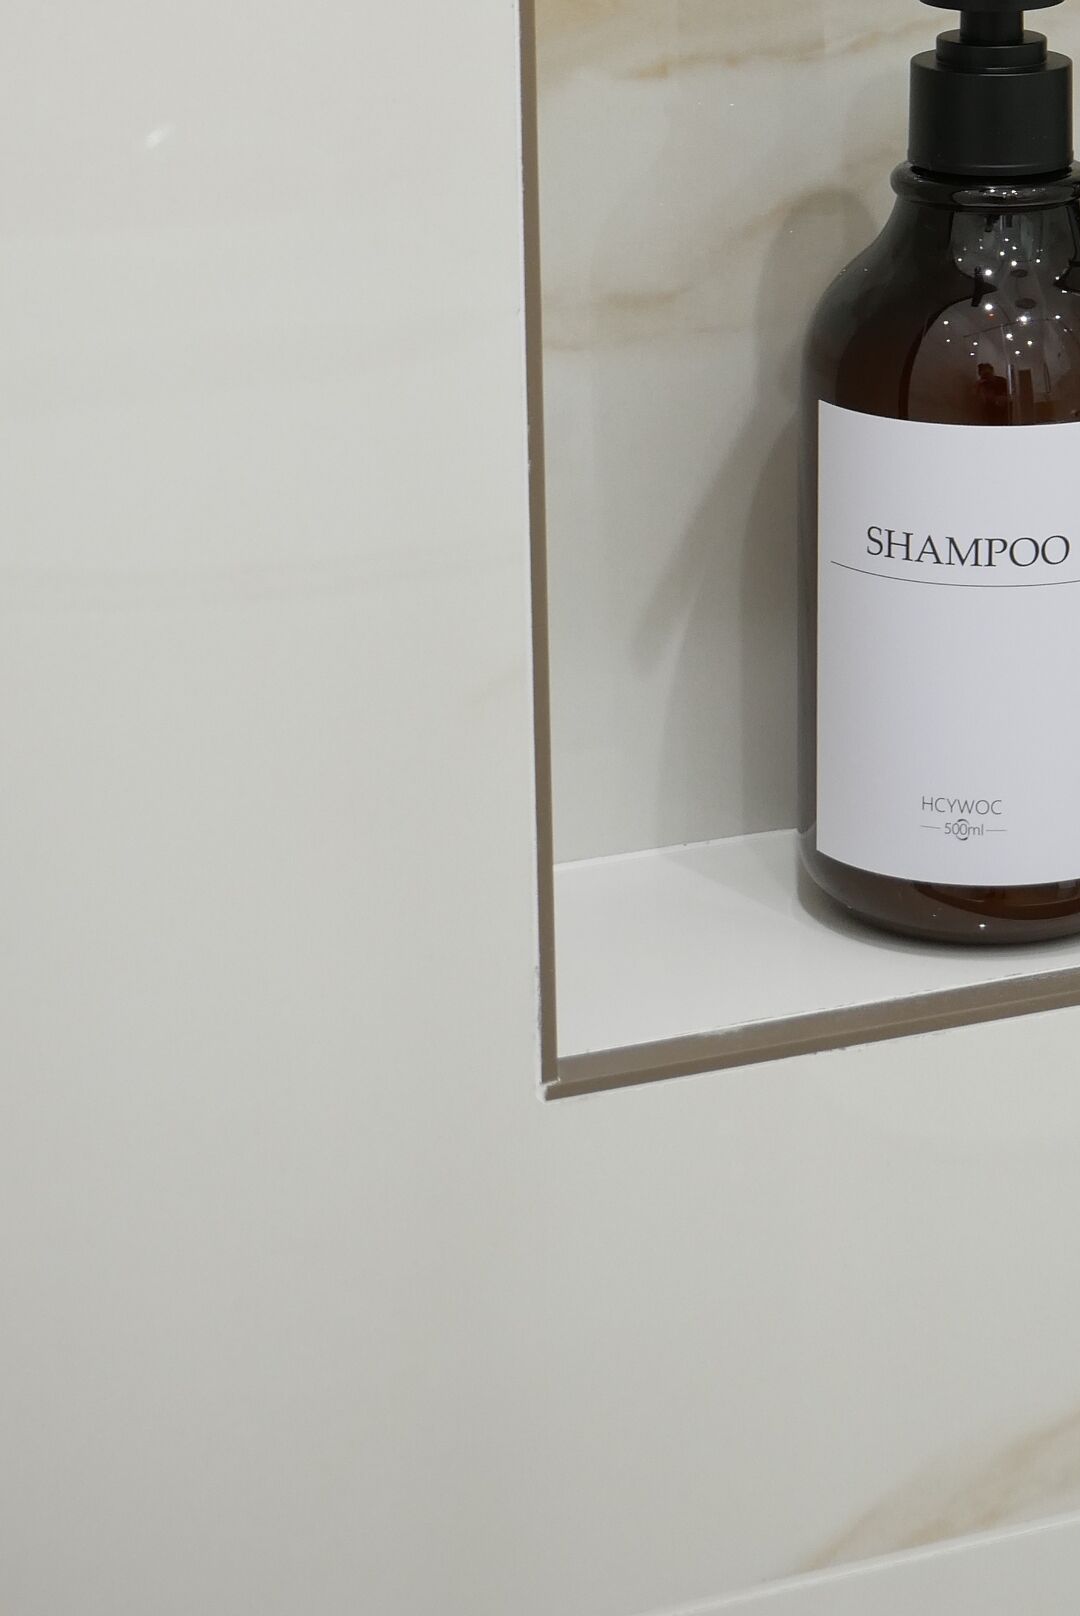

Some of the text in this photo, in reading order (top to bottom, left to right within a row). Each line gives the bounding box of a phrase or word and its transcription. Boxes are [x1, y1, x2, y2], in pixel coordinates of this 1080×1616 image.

[866, 525, 1070, 567] SHAMPOO
[922, 795, 1002, 815] HCYWOC
[944, 822, 984, 836] 500ml
